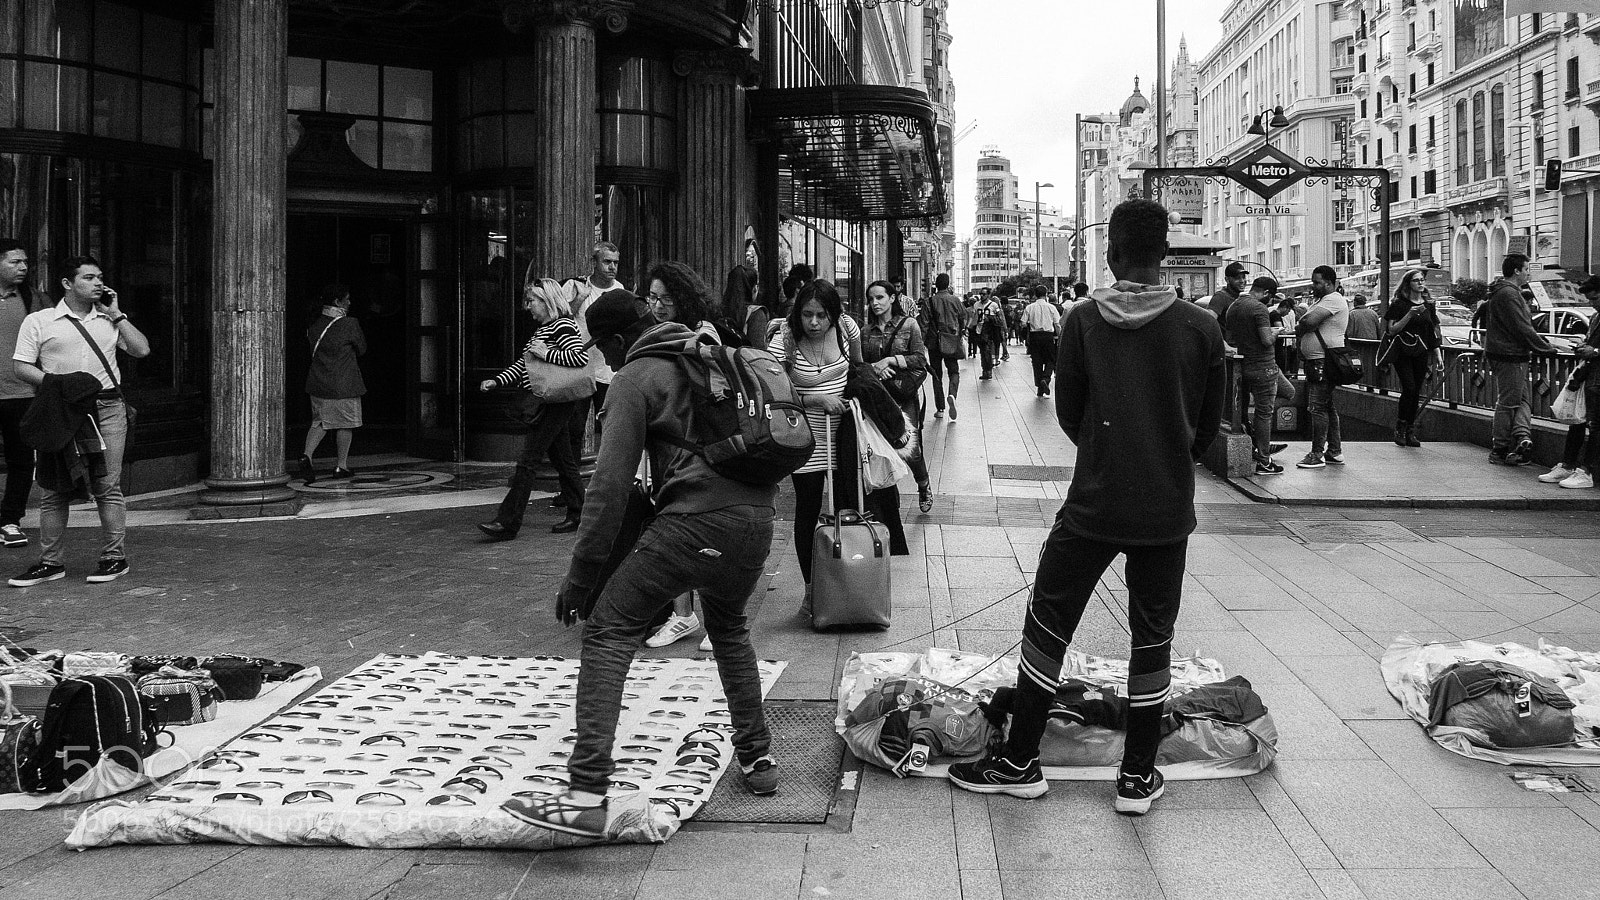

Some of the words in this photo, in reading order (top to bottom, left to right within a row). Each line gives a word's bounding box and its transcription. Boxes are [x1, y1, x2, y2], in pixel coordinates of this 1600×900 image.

[1251, 165, 1288, 177] Metro
[1245, 206, 1271, 215] Gran
[1166, 259, 1176, 267] 90
[1176, 259, 1206, 267] MILLONES
